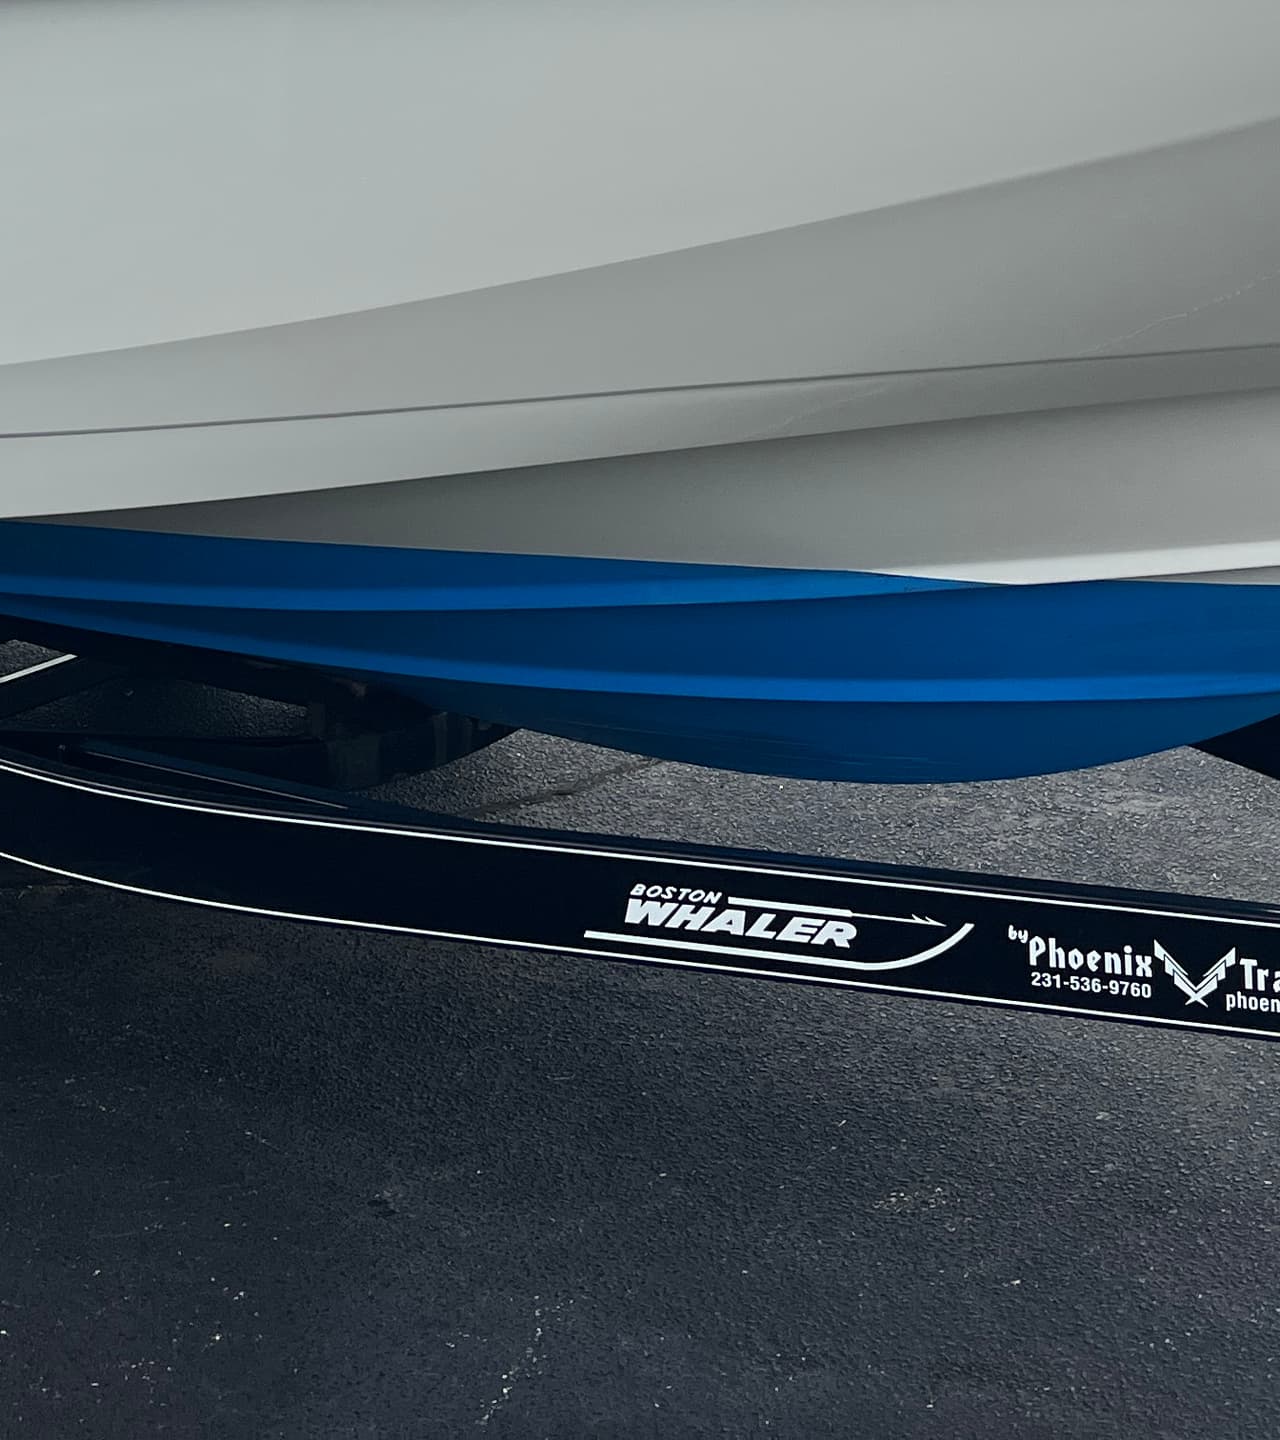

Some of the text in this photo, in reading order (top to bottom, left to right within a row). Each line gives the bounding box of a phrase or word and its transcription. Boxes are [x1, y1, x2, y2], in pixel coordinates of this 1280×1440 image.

[630, 883, 723, 905] BOSTON
[624, 898, 858, 949] WHALER
[1008, 925, 1029, 944] by
[1029, 935, 1153, 978] Phoenix
[1030, 971, 1152, 999] 231-536-9760
